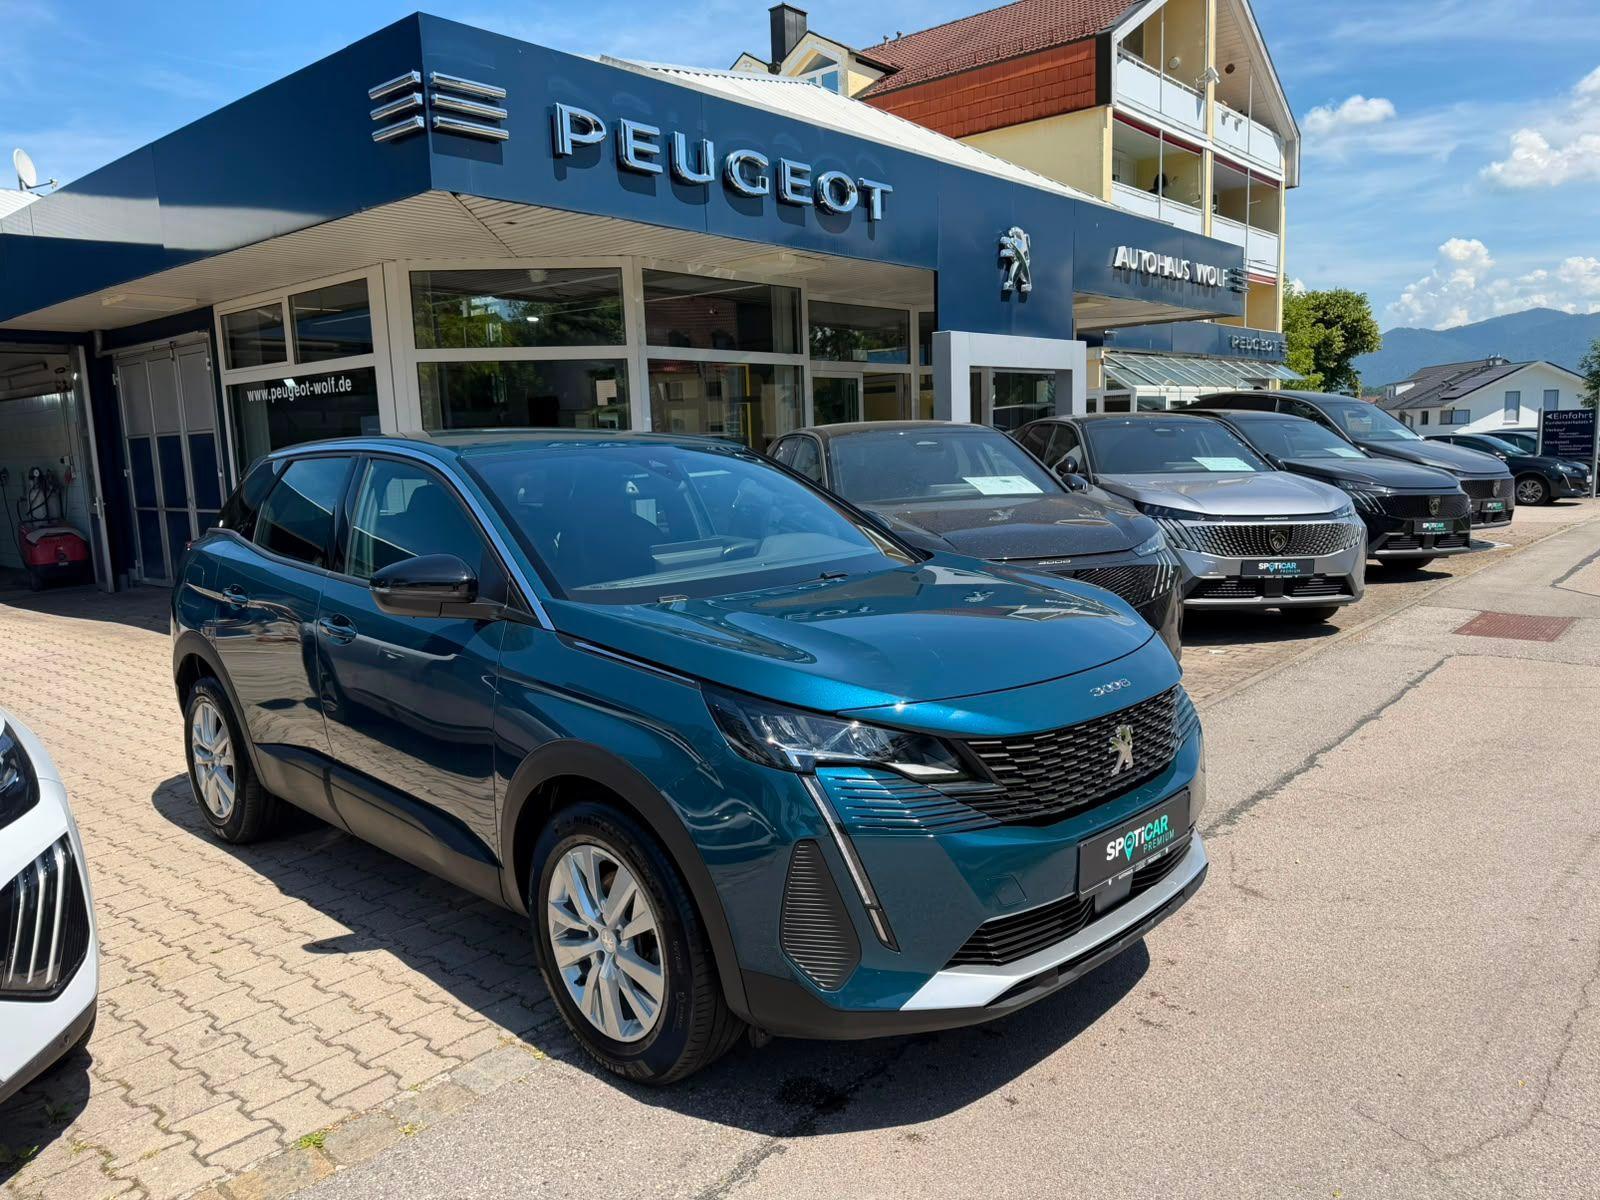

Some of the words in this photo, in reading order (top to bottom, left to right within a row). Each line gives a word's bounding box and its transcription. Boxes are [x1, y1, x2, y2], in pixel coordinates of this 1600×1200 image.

[553, 102, 893, 222] PEUGEOT
[1113, 246, 1190, 281] AUTOHAUS
[1195, 262, 1229, 287] WOLF
[1231, 335, 1279, 351] PEUGEOT
[247, 376, 352, 403] www.peugeot-wolf.de
[1553, 412, 1593, 420] Einfahrt
[1090, 678, 1131, 696] 3008
[1143, 829, 1175, 854] PREMIUM
